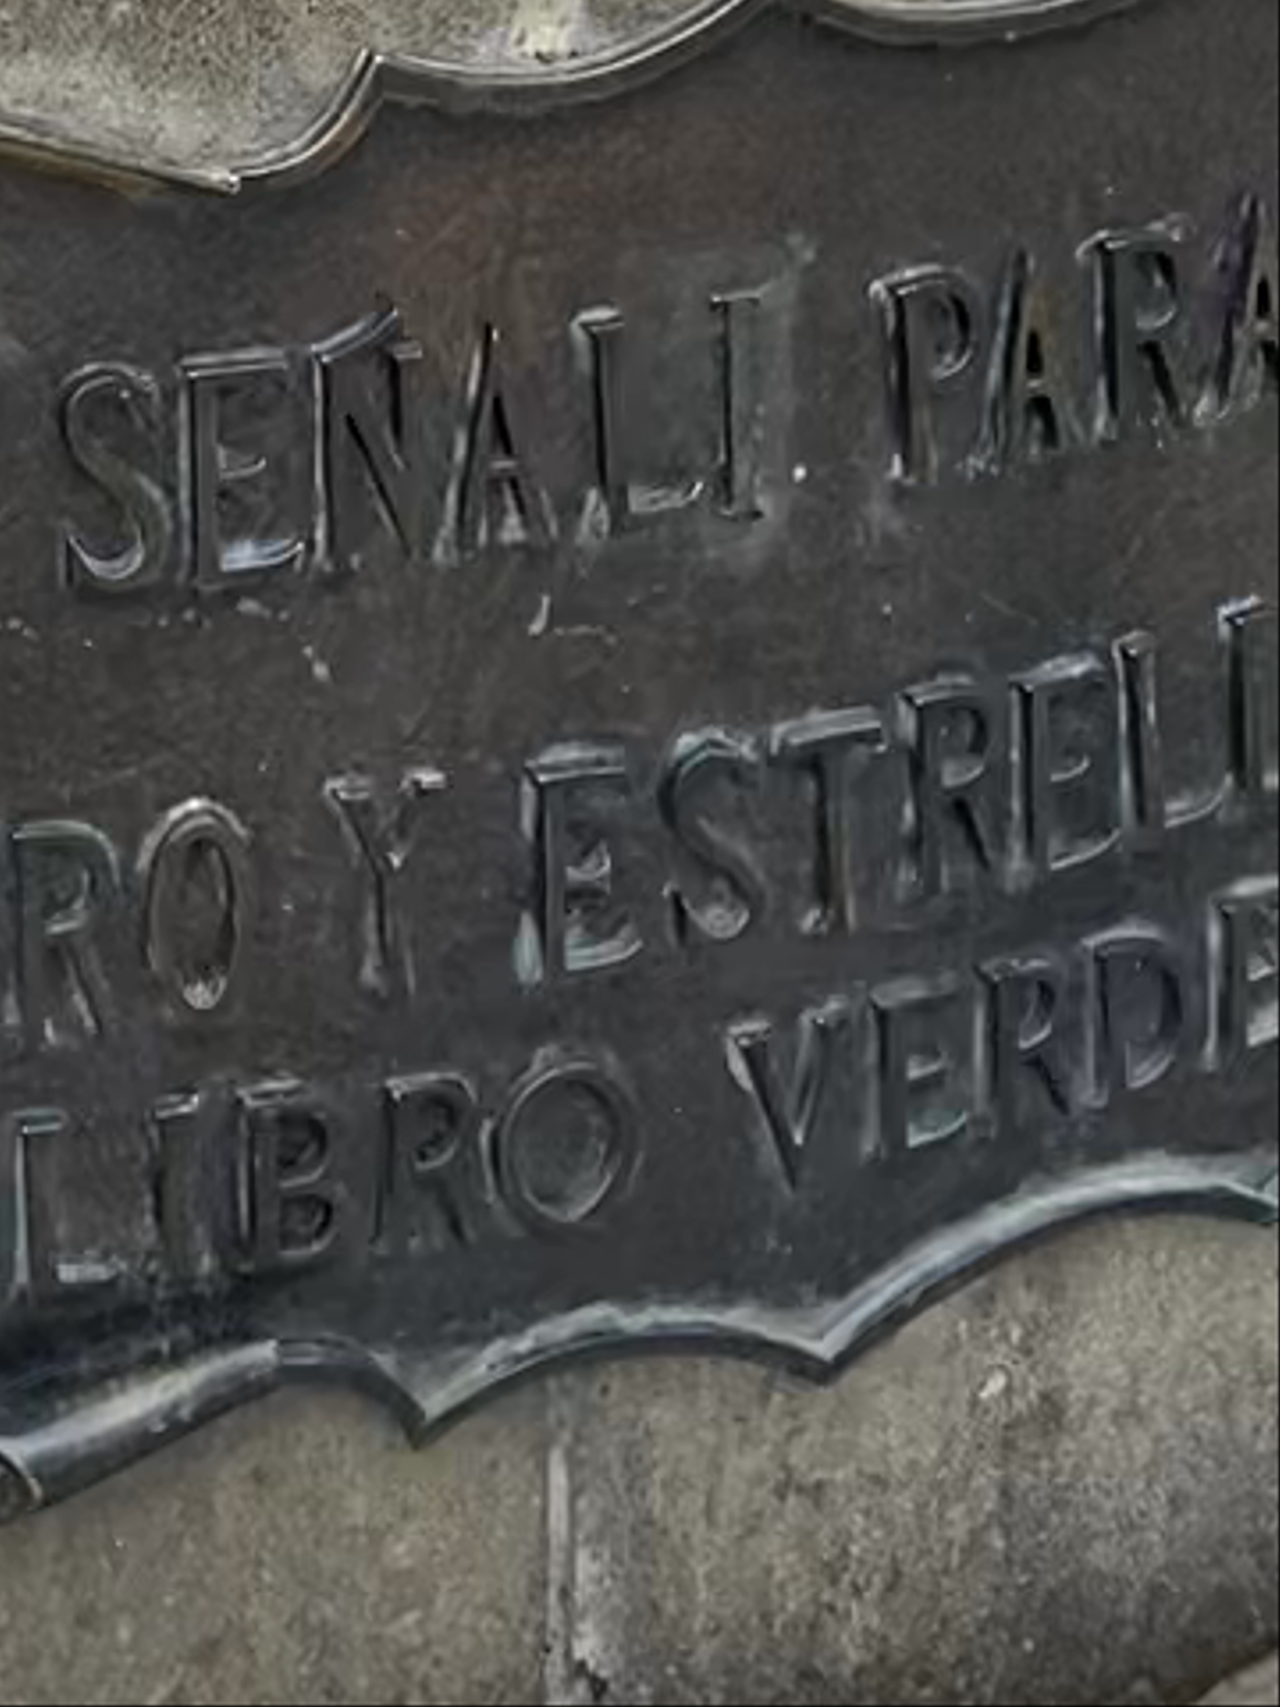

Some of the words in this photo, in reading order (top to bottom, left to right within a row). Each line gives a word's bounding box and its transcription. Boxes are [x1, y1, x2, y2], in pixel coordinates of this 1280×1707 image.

[868, 192, 1278, 484] PARA
[322, 766, 447, 998] Y
[10, 1044, 636, 1298] LIBRO
[724, 875, 1278, 1194] VERDE
